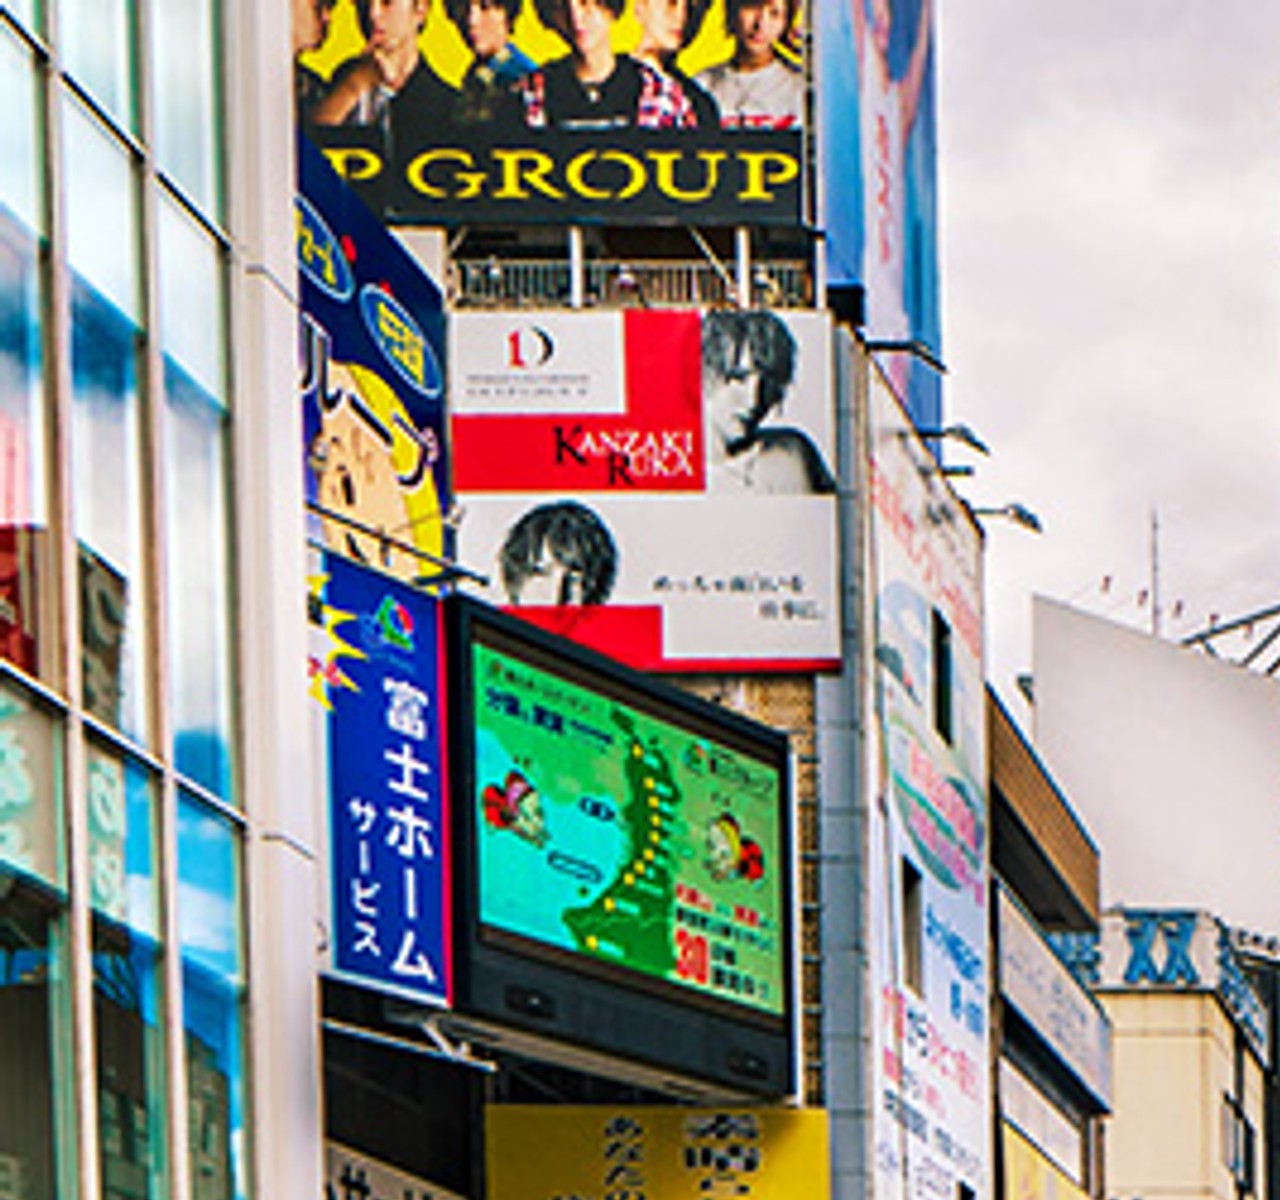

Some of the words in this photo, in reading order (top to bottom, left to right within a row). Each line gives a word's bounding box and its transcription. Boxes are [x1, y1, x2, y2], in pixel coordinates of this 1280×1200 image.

[405, 148, 799, 202] GROUP
[553, 425, 694, 465] KANZAKI
[609, 449, 695, 485] RUKA
[383, 675, 438, 986] 富士ホーム
[349, 796, 382, 958] サービス
